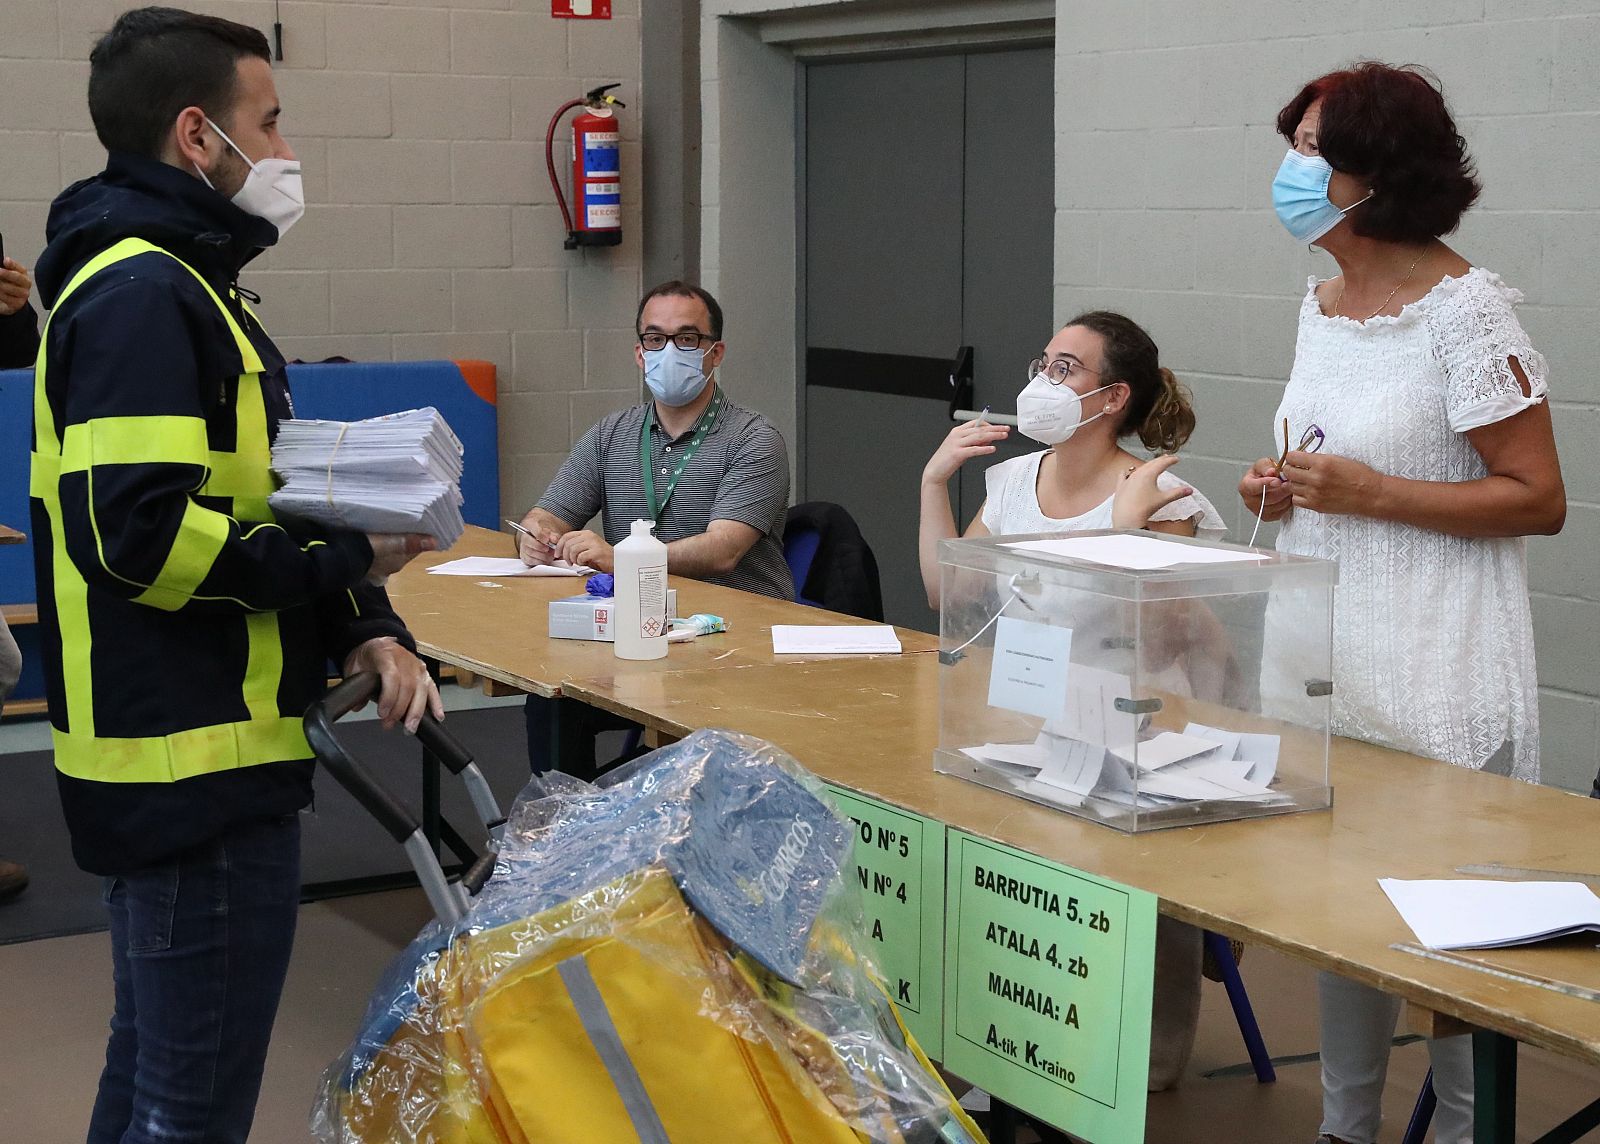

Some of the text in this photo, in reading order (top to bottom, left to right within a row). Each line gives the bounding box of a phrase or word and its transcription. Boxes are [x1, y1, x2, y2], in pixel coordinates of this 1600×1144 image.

[899, 835, 909, 858] 5
[896, 882, 907, 904] 4
[974, 865, 1110, 933] BARRUTIA 5. zb
[872, 918, 884, 942] A
[986, 921, 1089, 979] ATALA 4. zb
[898, 979, 911, 1003] K
[988, 972, 1079, 1030] MAHAIA: A
[986, 1023, 1076, 1085] A-tik K-raino
